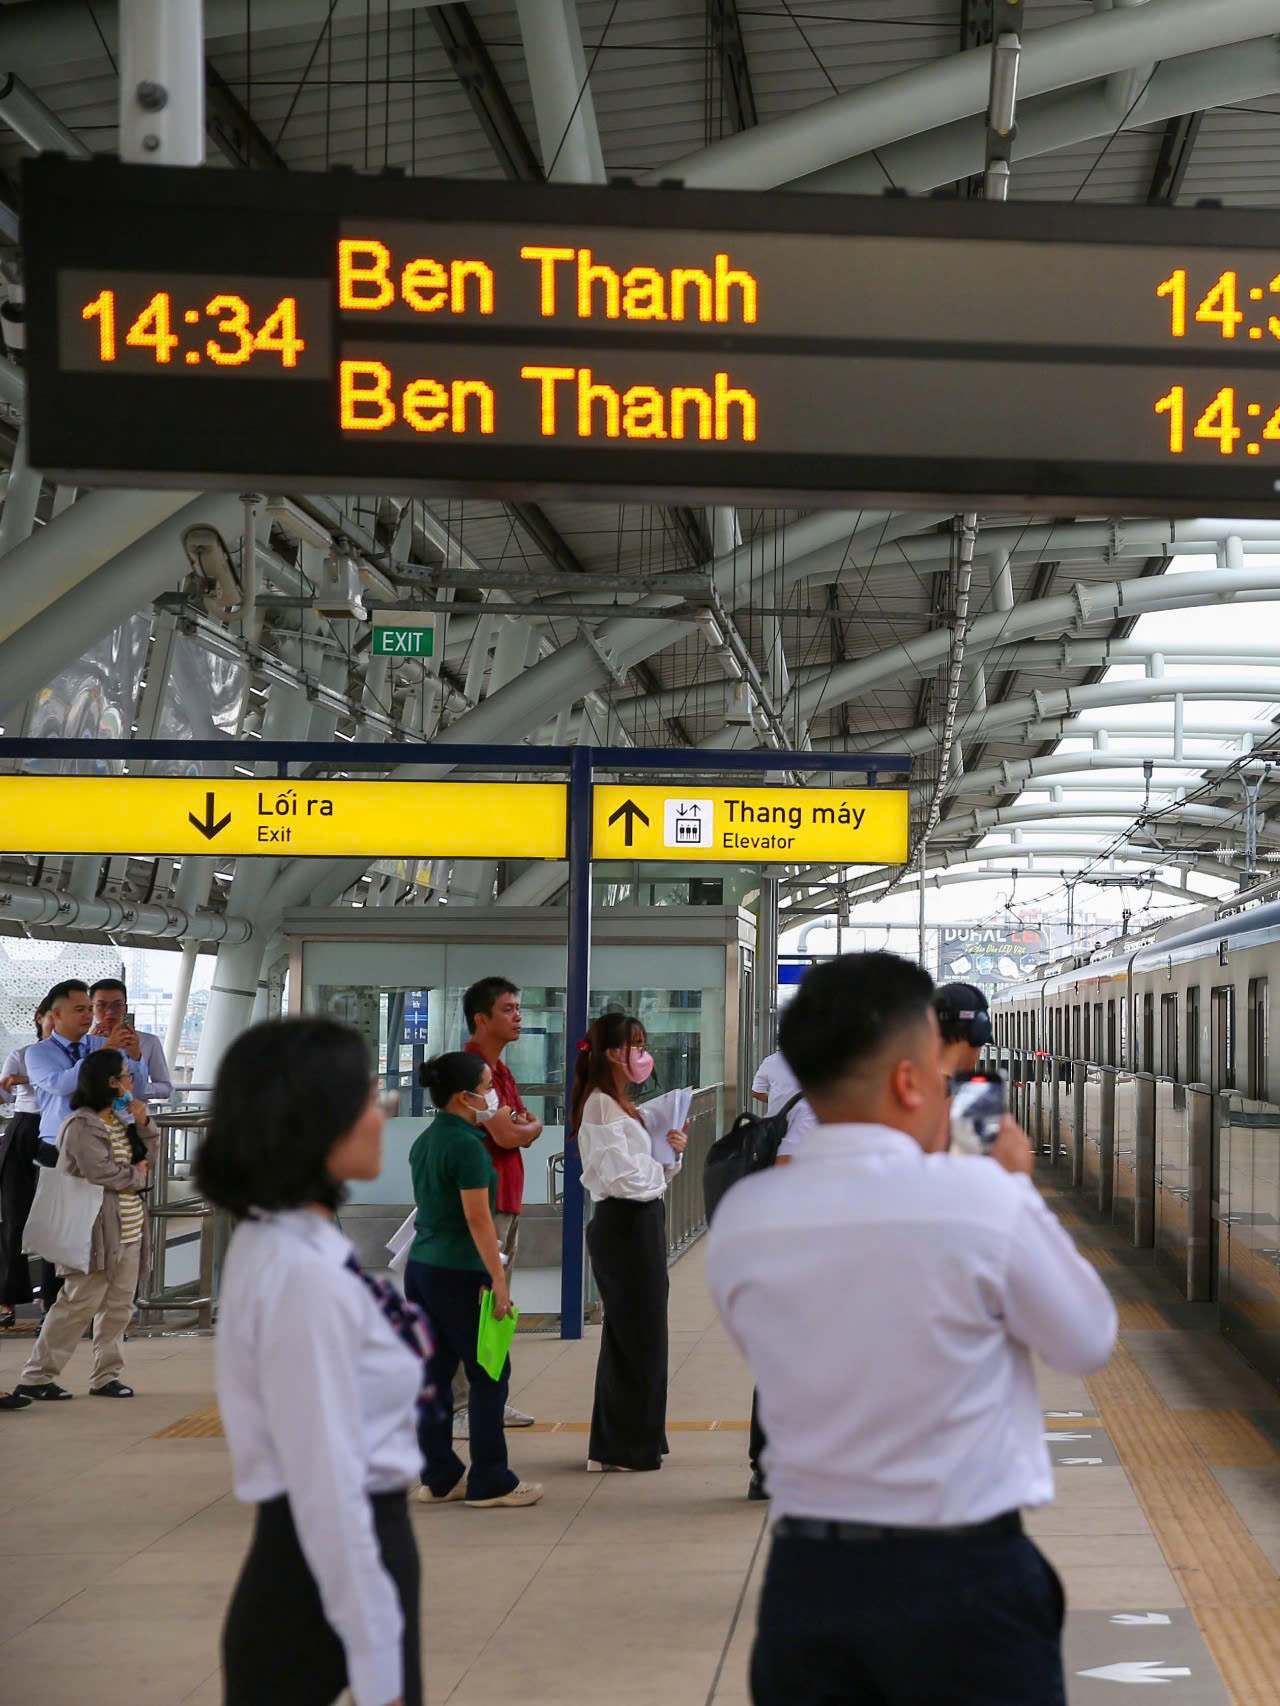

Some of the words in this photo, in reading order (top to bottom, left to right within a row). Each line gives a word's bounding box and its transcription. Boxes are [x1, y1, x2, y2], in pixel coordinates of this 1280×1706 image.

[338, 240, 494, 315] Ben
[520, 246, 758, 323] Thanh
[82, 291, 305, 368] 14:34
[339, 360, 495, 435] Ben
[520, 366, 758, 441] Thanh
[382, 631, 424, 652] EXIT
[258, 789, 297, 816] Lối
[307, 799, 333, 816] ra
[723, 800, 802, 830] Thang
[812, 801, 866, 830] máy
[257, 825, 292, 842] Exit
[723, 832, 796, 849] Elevator
